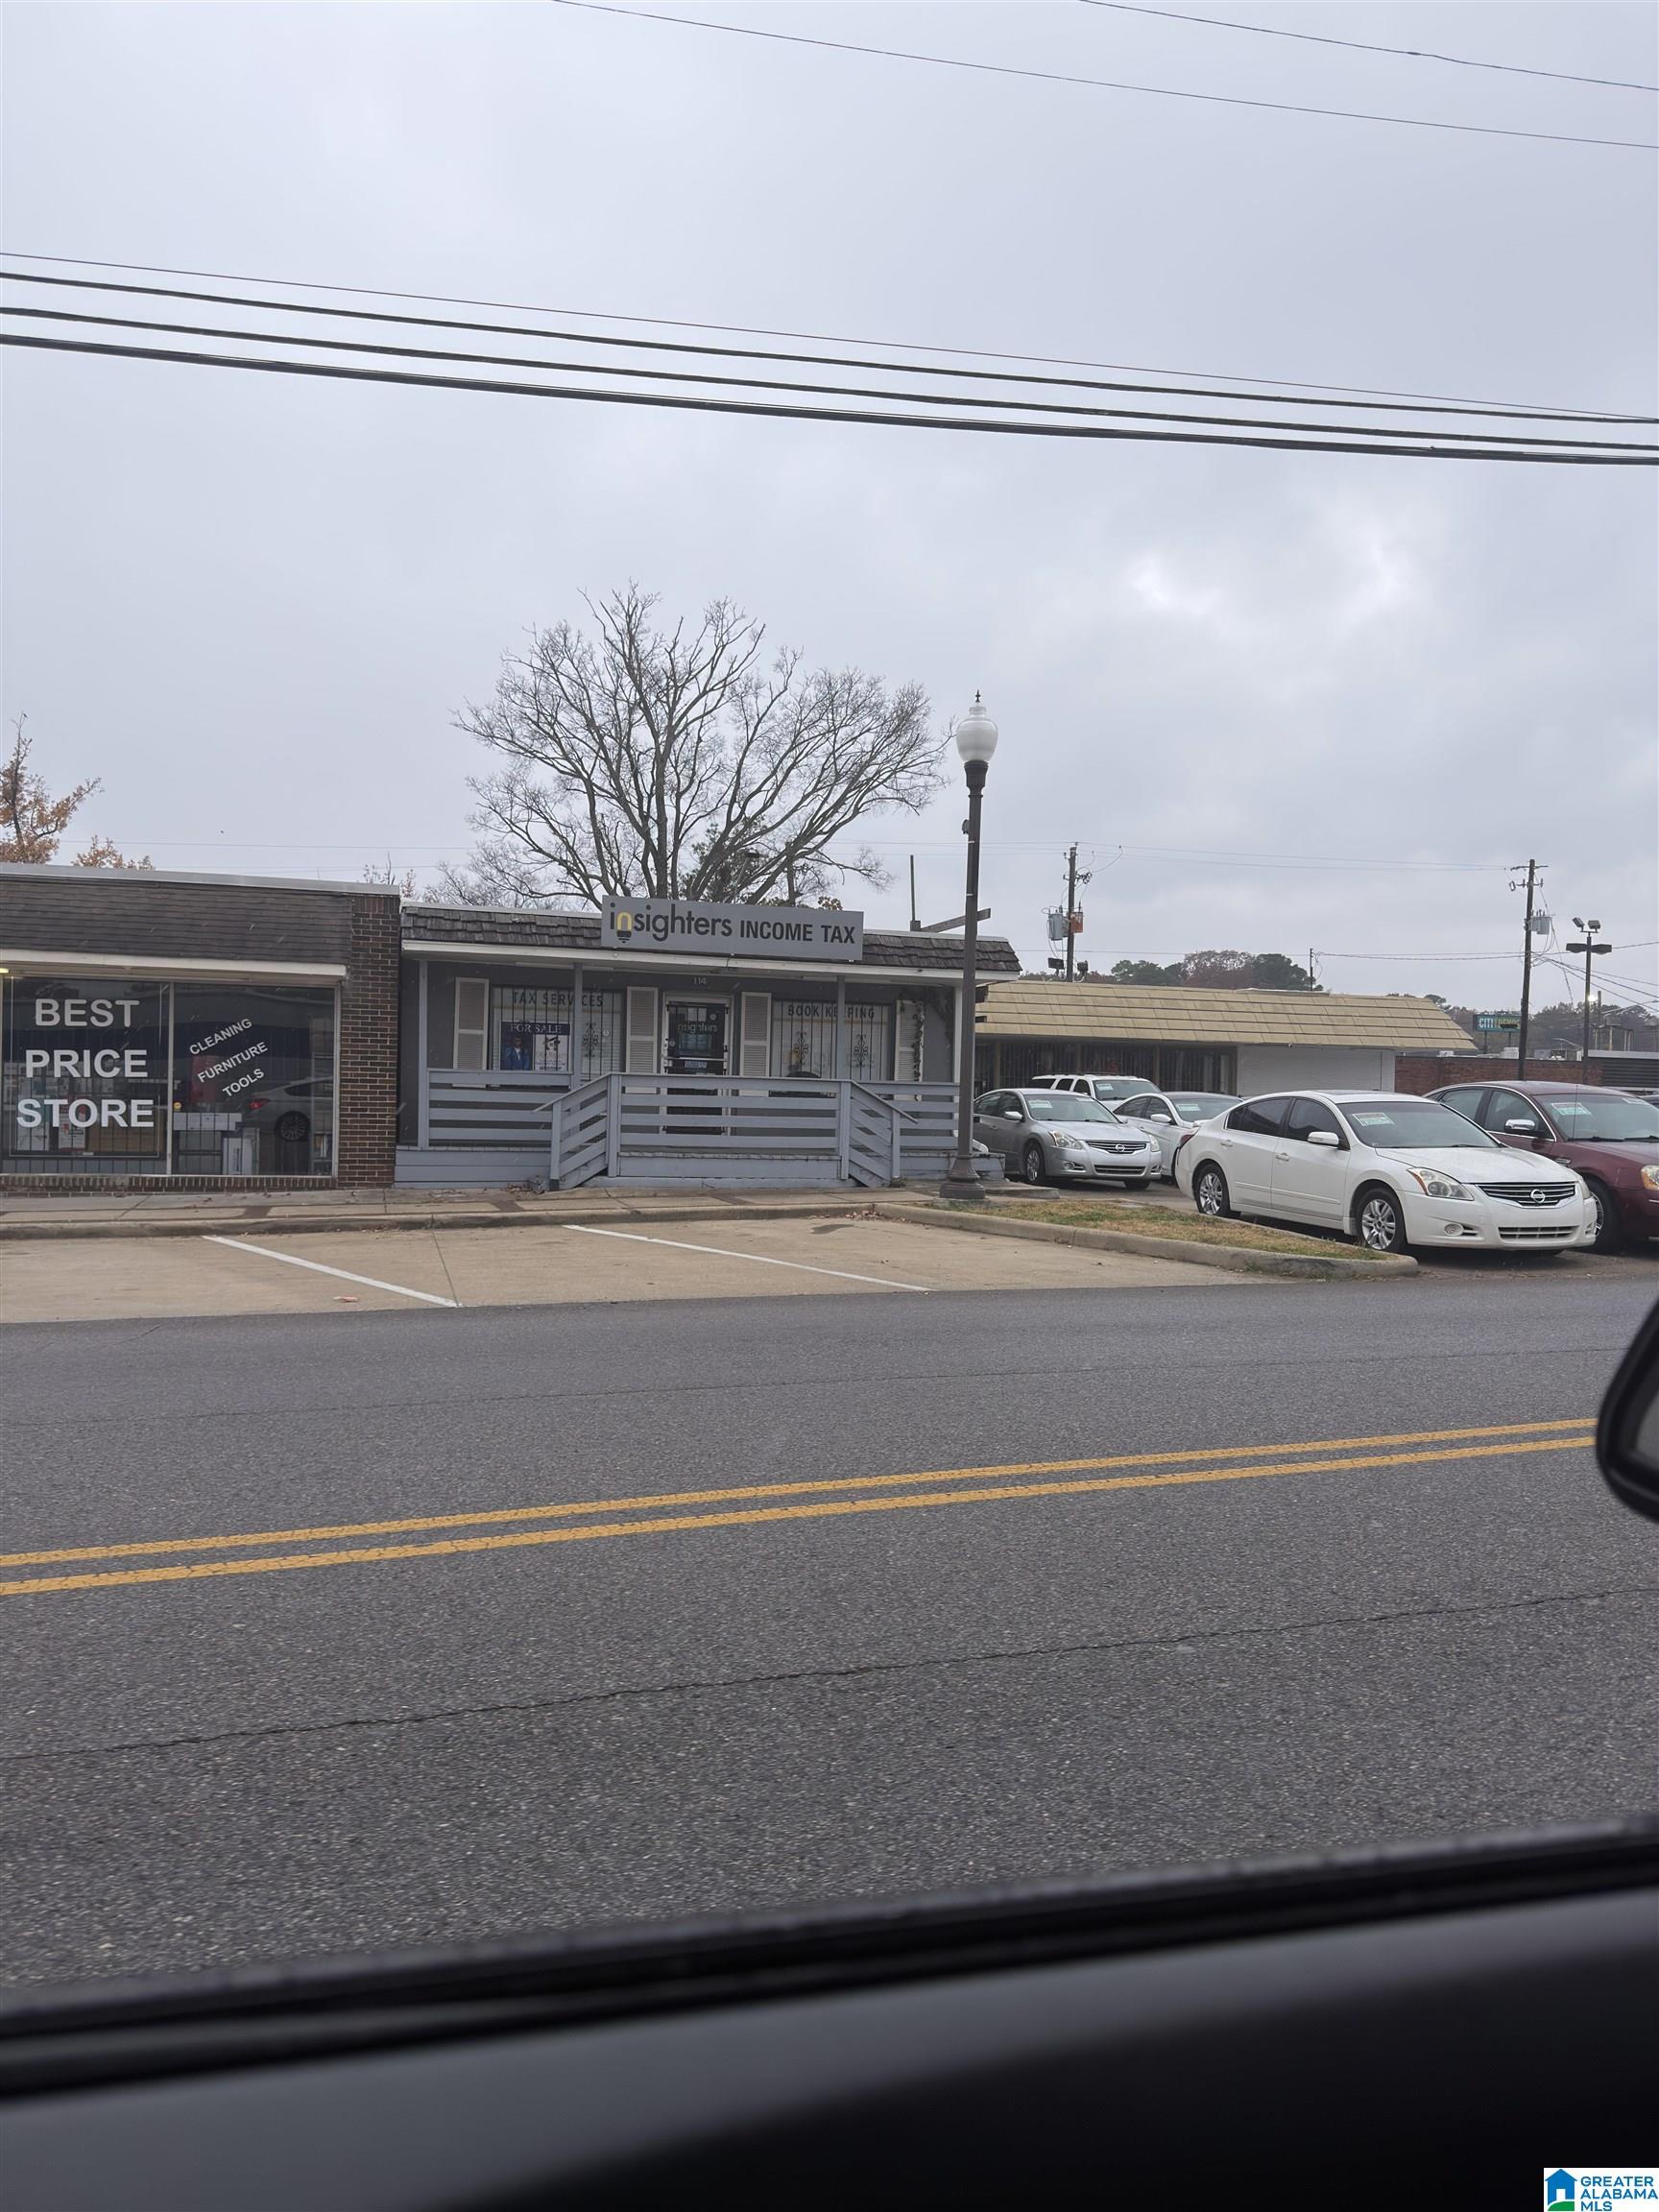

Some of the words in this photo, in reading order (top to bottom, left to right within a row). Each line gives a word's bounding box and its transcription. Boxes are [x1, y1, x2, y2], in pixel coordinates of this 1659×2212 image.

[610, 902, 733, 942] insighters
[740, 920, 813, 942] INCOME
[821, 925, 855, 944] TAX
[35, 998, 140, 1027] BEST
[513, 991, 537, 1004] TAX
[541, 992, 604, 1007] SERVCES
[826, 1006, 875, 1019] KEPING
[189, 1018, 252, 1056] CLEANING
[510, 1022, 532, 1033] FOR
[535, 1023, 562, 1034] SALE
[1479, 1018, 1494, 1028] CITI
[26, 1048, 148, 1078] PRICE
[197, 1041, 268, 1083] FURNITURE
[222, 1068, 264, 1098] TOOLS
[16, 1098, 154, 1128] STORE
